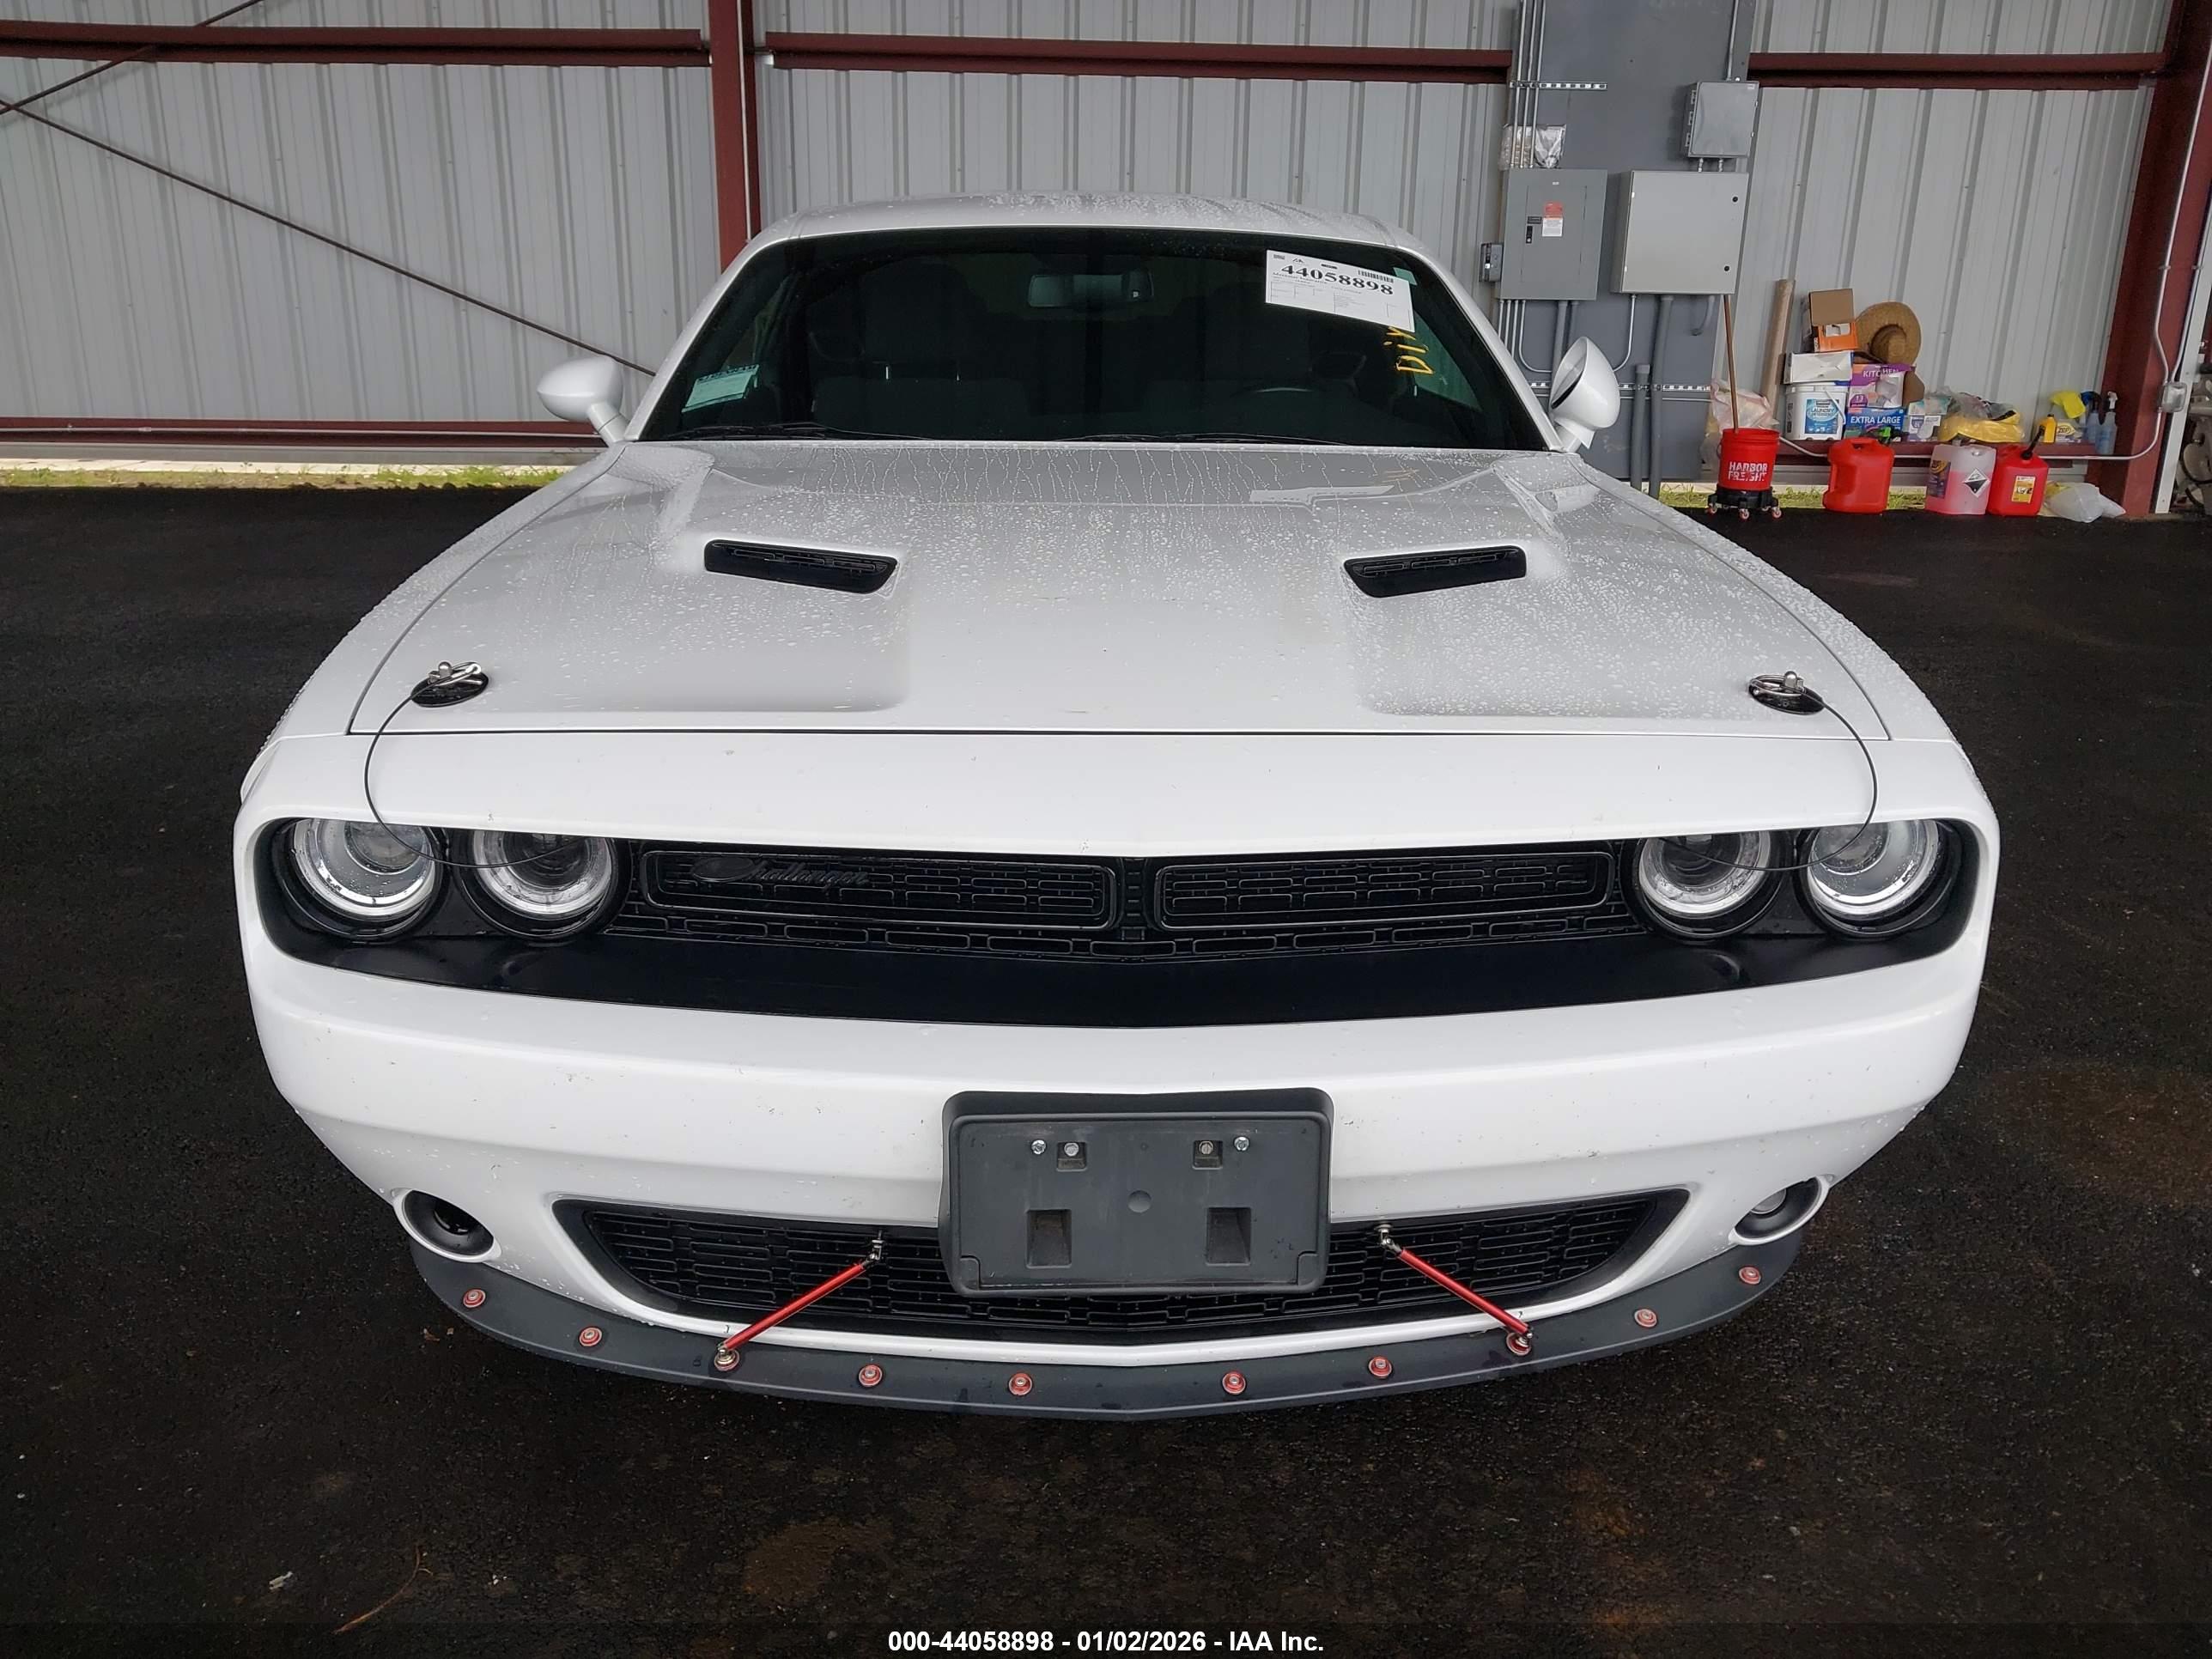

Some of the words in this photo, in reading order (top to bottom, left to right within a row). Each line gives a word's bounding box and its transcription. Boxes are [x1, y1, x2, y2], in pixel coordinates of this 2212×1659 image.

[1281, 264, 1394, 295] 44058898
[1850, 416, 1875, 424] EXTRA
[1877, 416, 1901, 424] LARGE
[1729, 461, 1768, 472] HARBOR
[690, 857, 870, 895] hallenger
